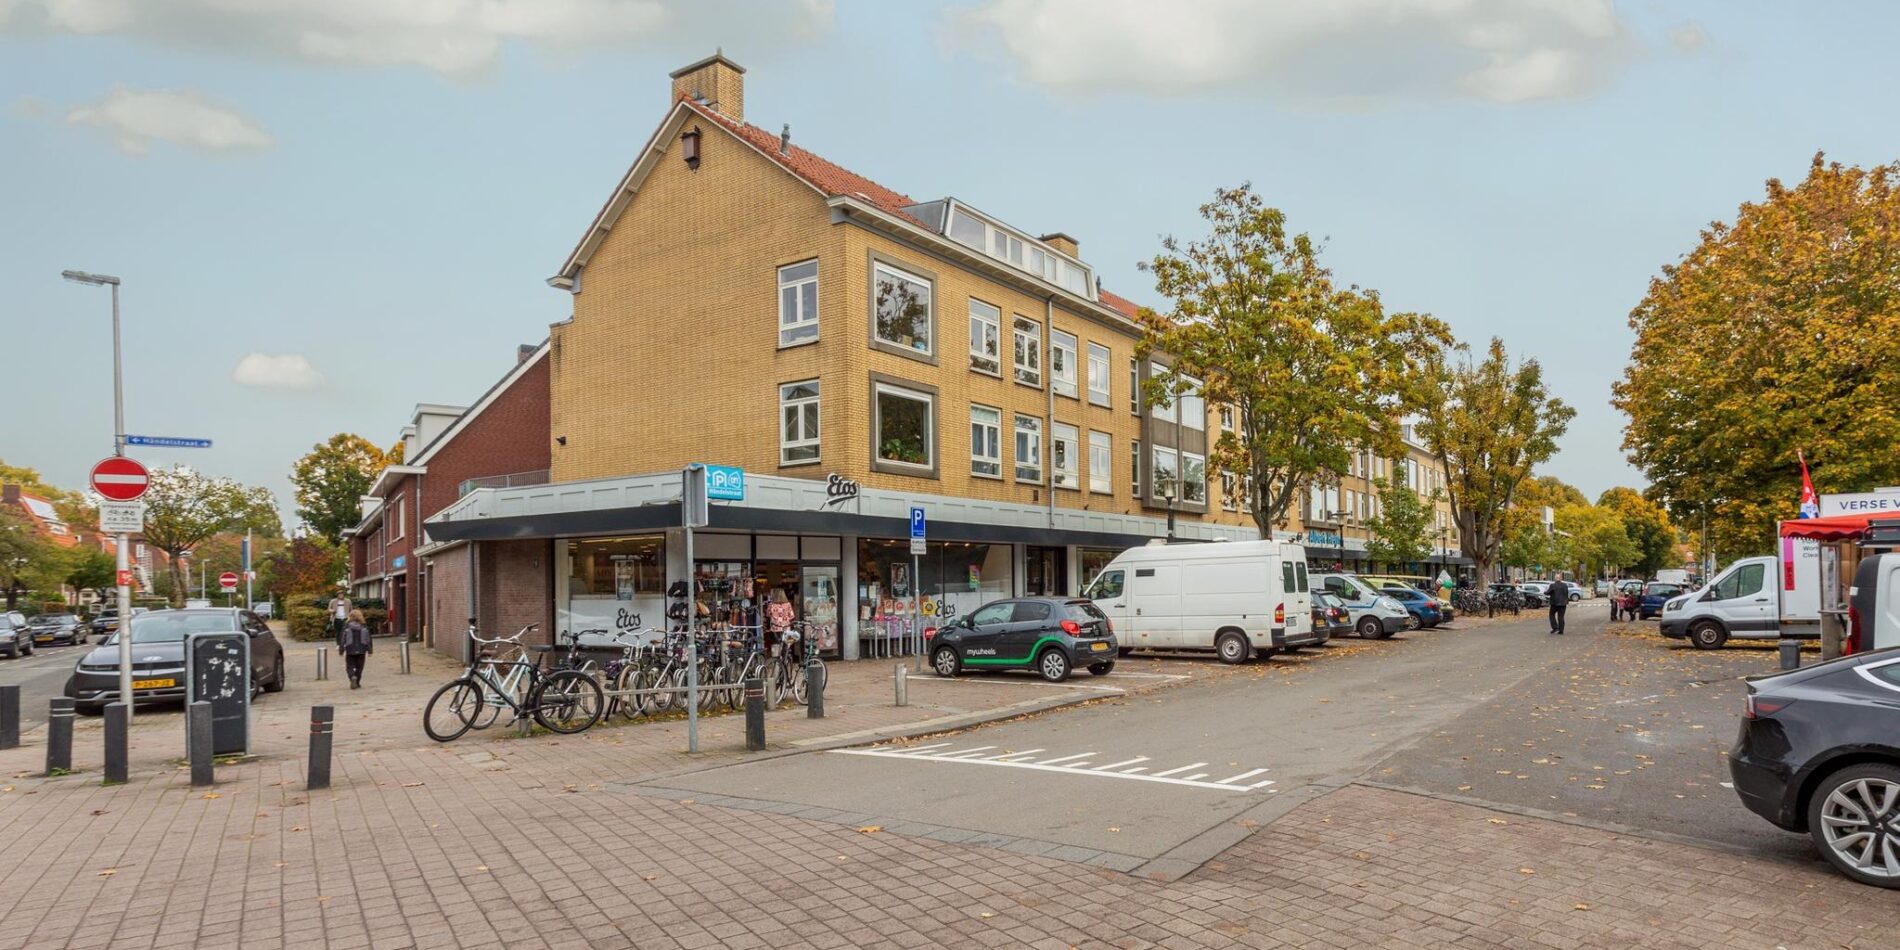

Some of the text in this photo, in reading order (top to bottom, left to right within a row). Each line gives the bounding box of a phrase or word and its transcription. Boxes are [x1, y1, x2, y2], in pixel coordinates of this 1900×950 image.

[827, 474, 857, 497] Etos
[1839, 499, 1888, 510] VERSE
[914, 510, 923, 527] P
[935, 599, 956, 618] Eos
[616, 608, 642, 629] Etos
[966, 647, 996, 657] mywheels
